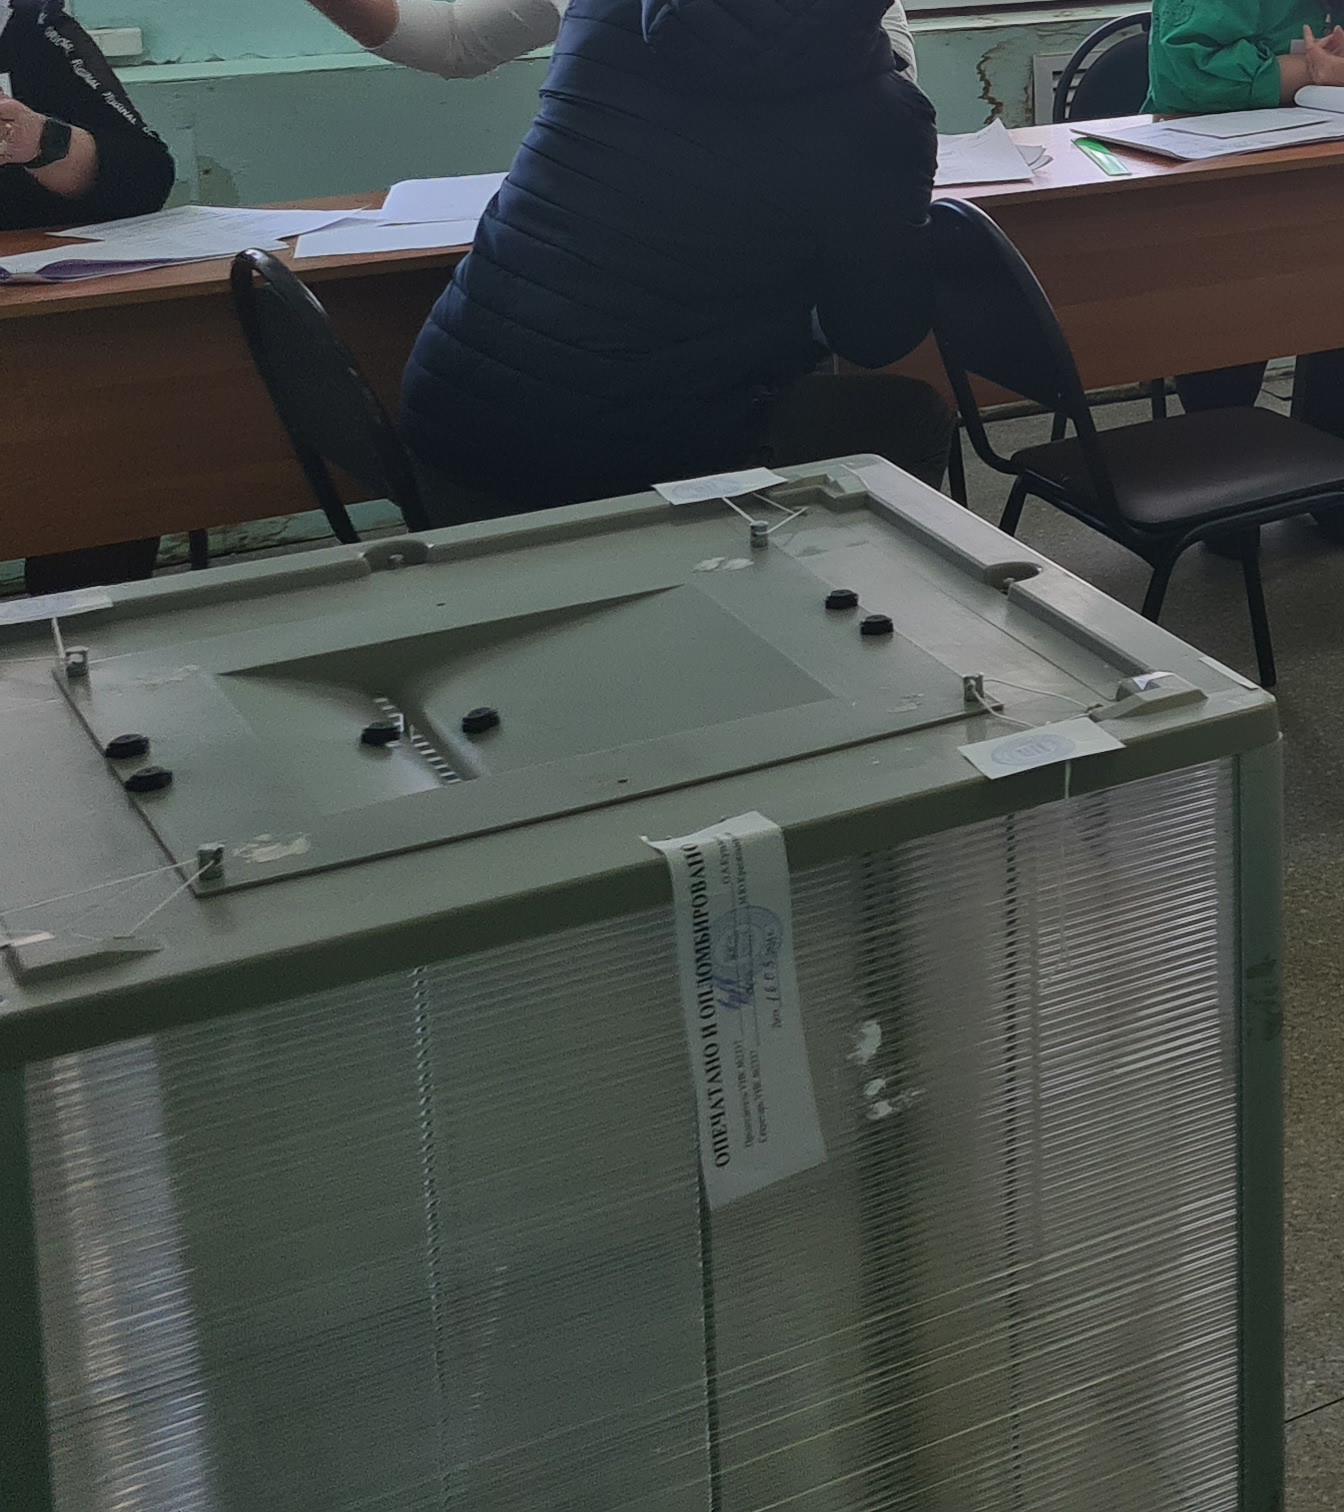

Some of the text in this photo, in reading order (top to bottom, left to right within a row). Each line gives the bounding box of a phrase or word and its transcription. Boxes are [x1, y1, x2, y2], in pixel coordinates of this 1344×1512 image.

[680, 843, 731, 1169] ОПЕЧАТАНО И ОПЛОМБИРОВАНО
